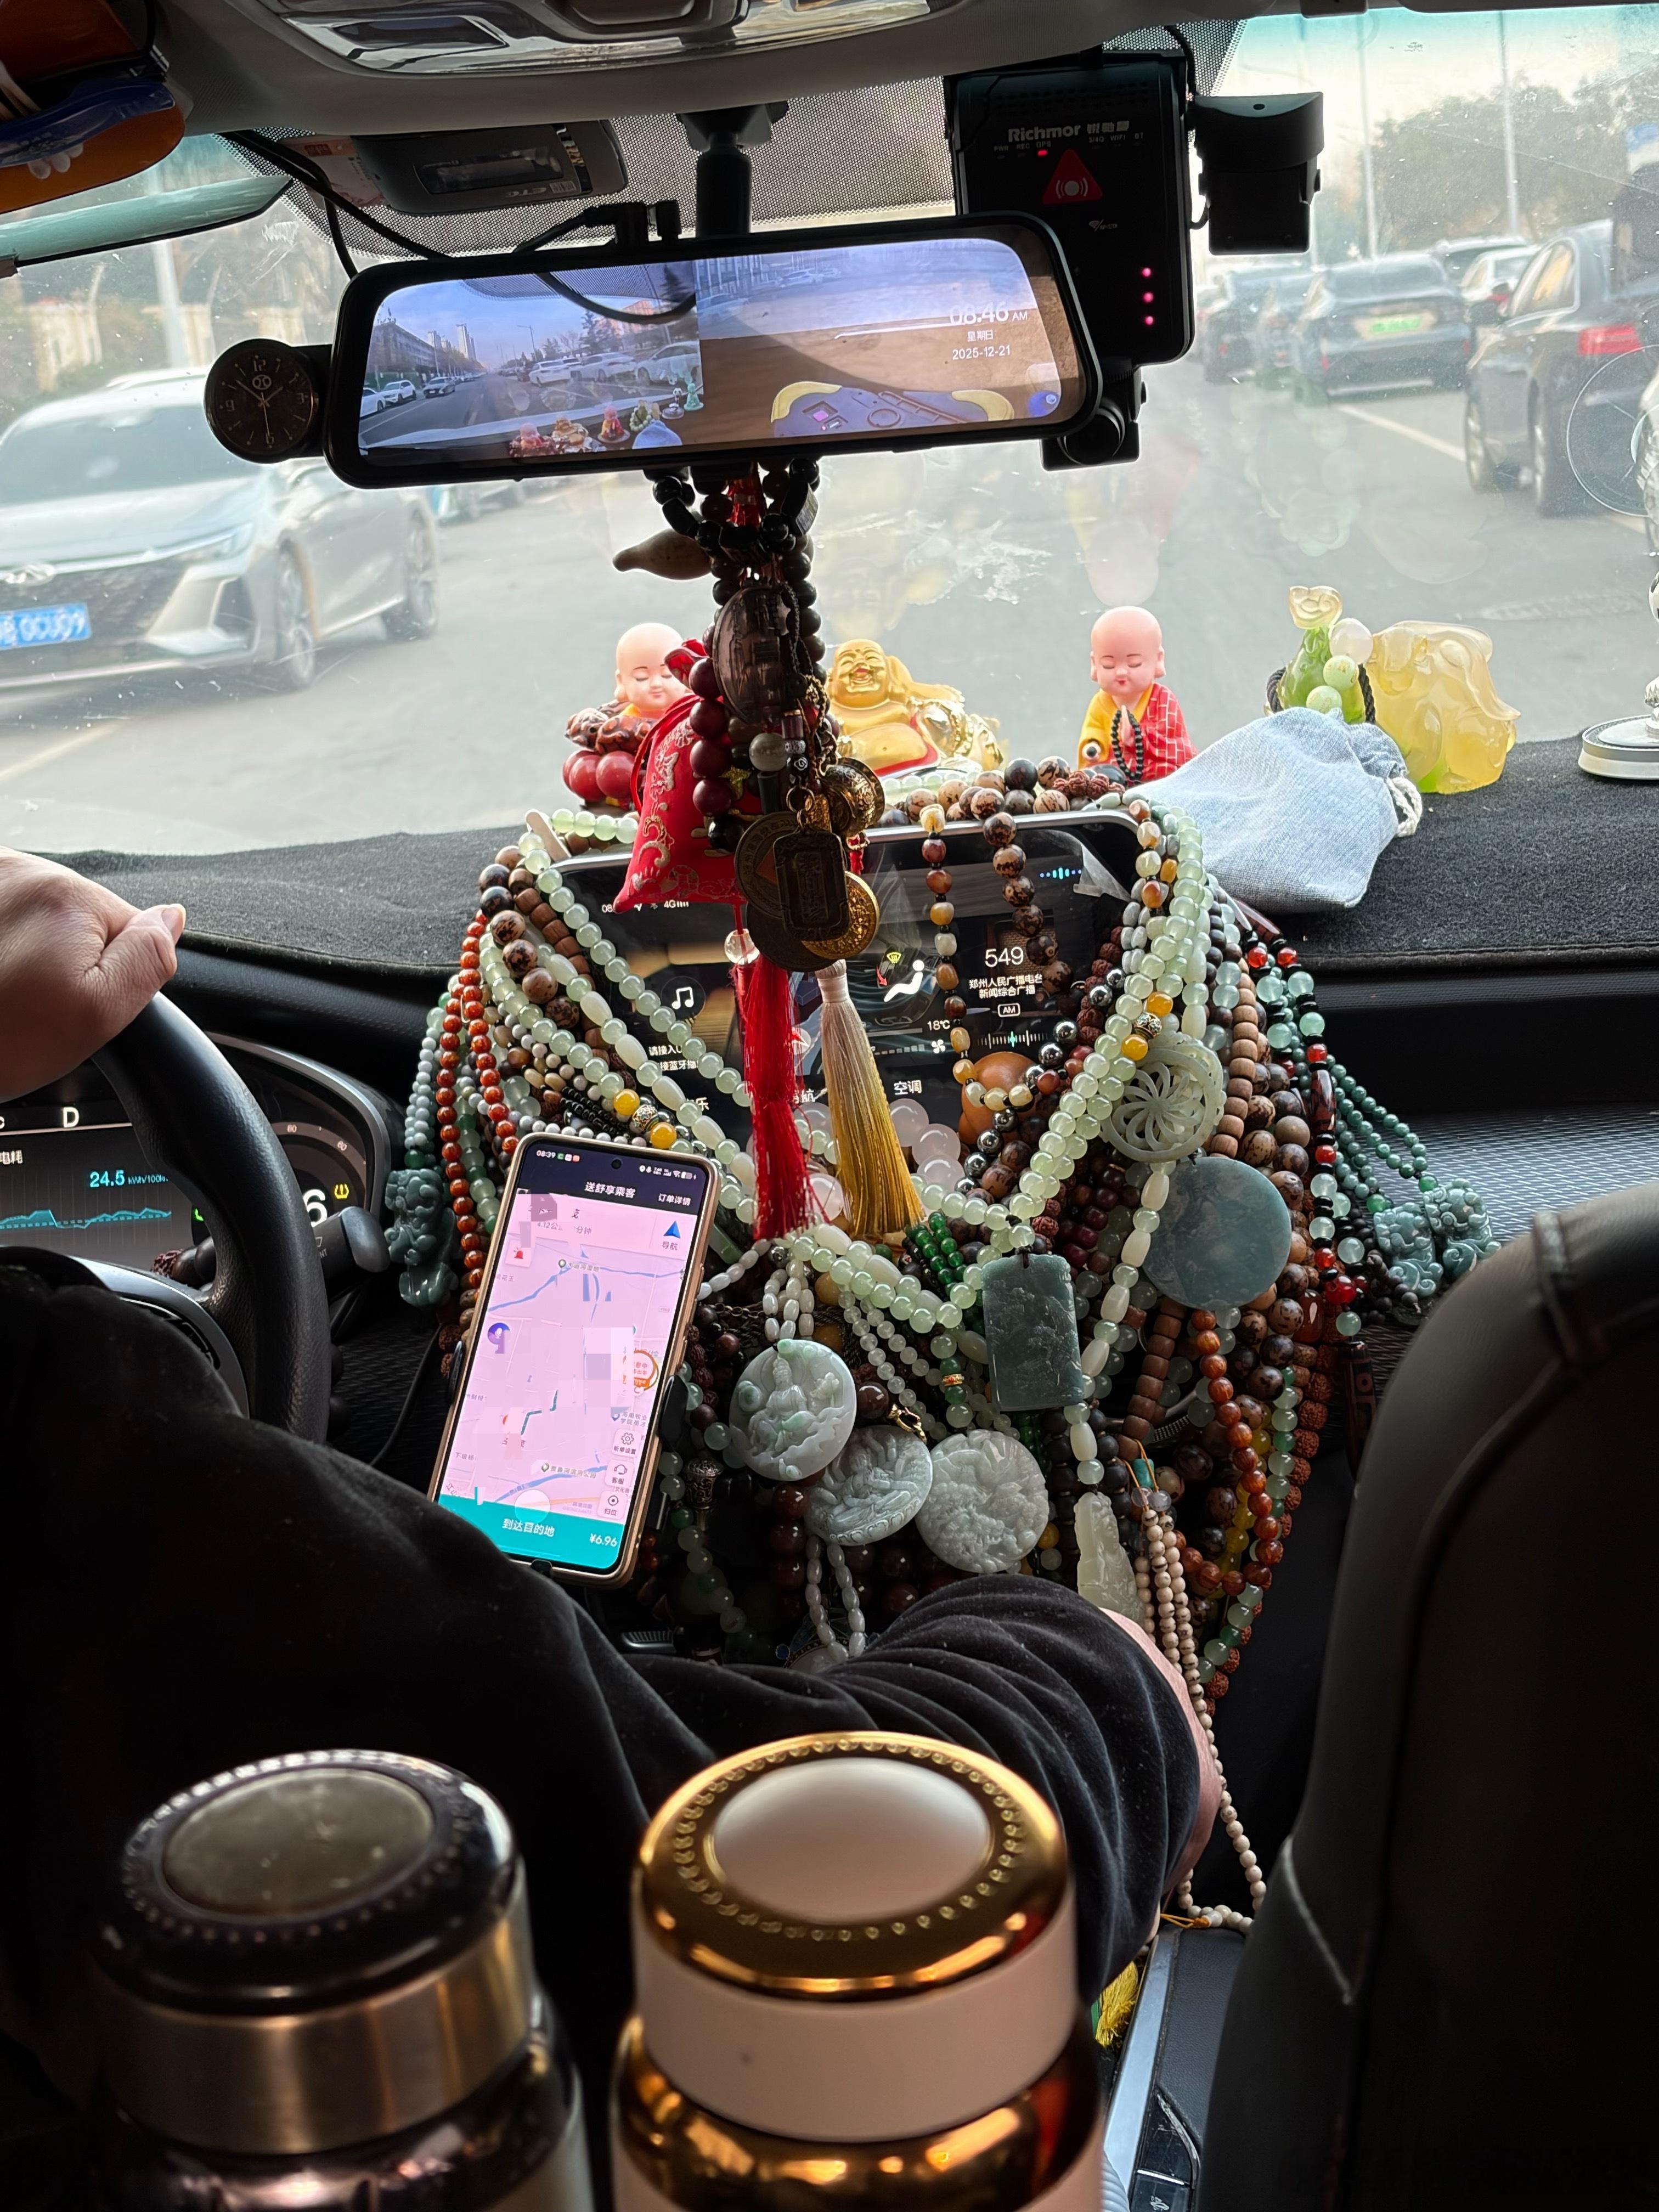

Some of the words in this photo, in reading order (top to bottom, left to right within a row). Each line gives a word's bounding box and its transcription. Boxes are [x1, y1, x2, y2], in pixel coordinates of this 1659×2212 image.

[1008, 125, 1081, 143] Richmor
[1012, 311, 1028, 322] AM
[967, 329, 994, 343] 星期日
[952, 345, 1011, 360] 2025-12-21
[663, 900, 676, 909] 4G
[985, 946, 1024, 967] 549
[969, 973, 1042, 990] 郑州人民广播电台
[979, 984, 1036, 999] 新闻综合广播
[1003, 1006, 1015, 1014] AM
[893, 1080, 923, 1096] 空调
[63, 1106, 80, 1128] D
[536, 1149, 556, 1159] 08:39
[89, 1169, 125, 1188] 24.5
[584, 1181, 636, 1199] 送舒享乘客
[658, 1193, 691, 1206] 订单详情
[537, 1221, 562, 1231] 4.12公
[662, 1241, 678, 1251] 导航
[613, 1445, 636, 1455] 听单设置
[501, 1518, 555, 1537] 到达目的地
[589, 1533, 618, 1548] ¥6.96
